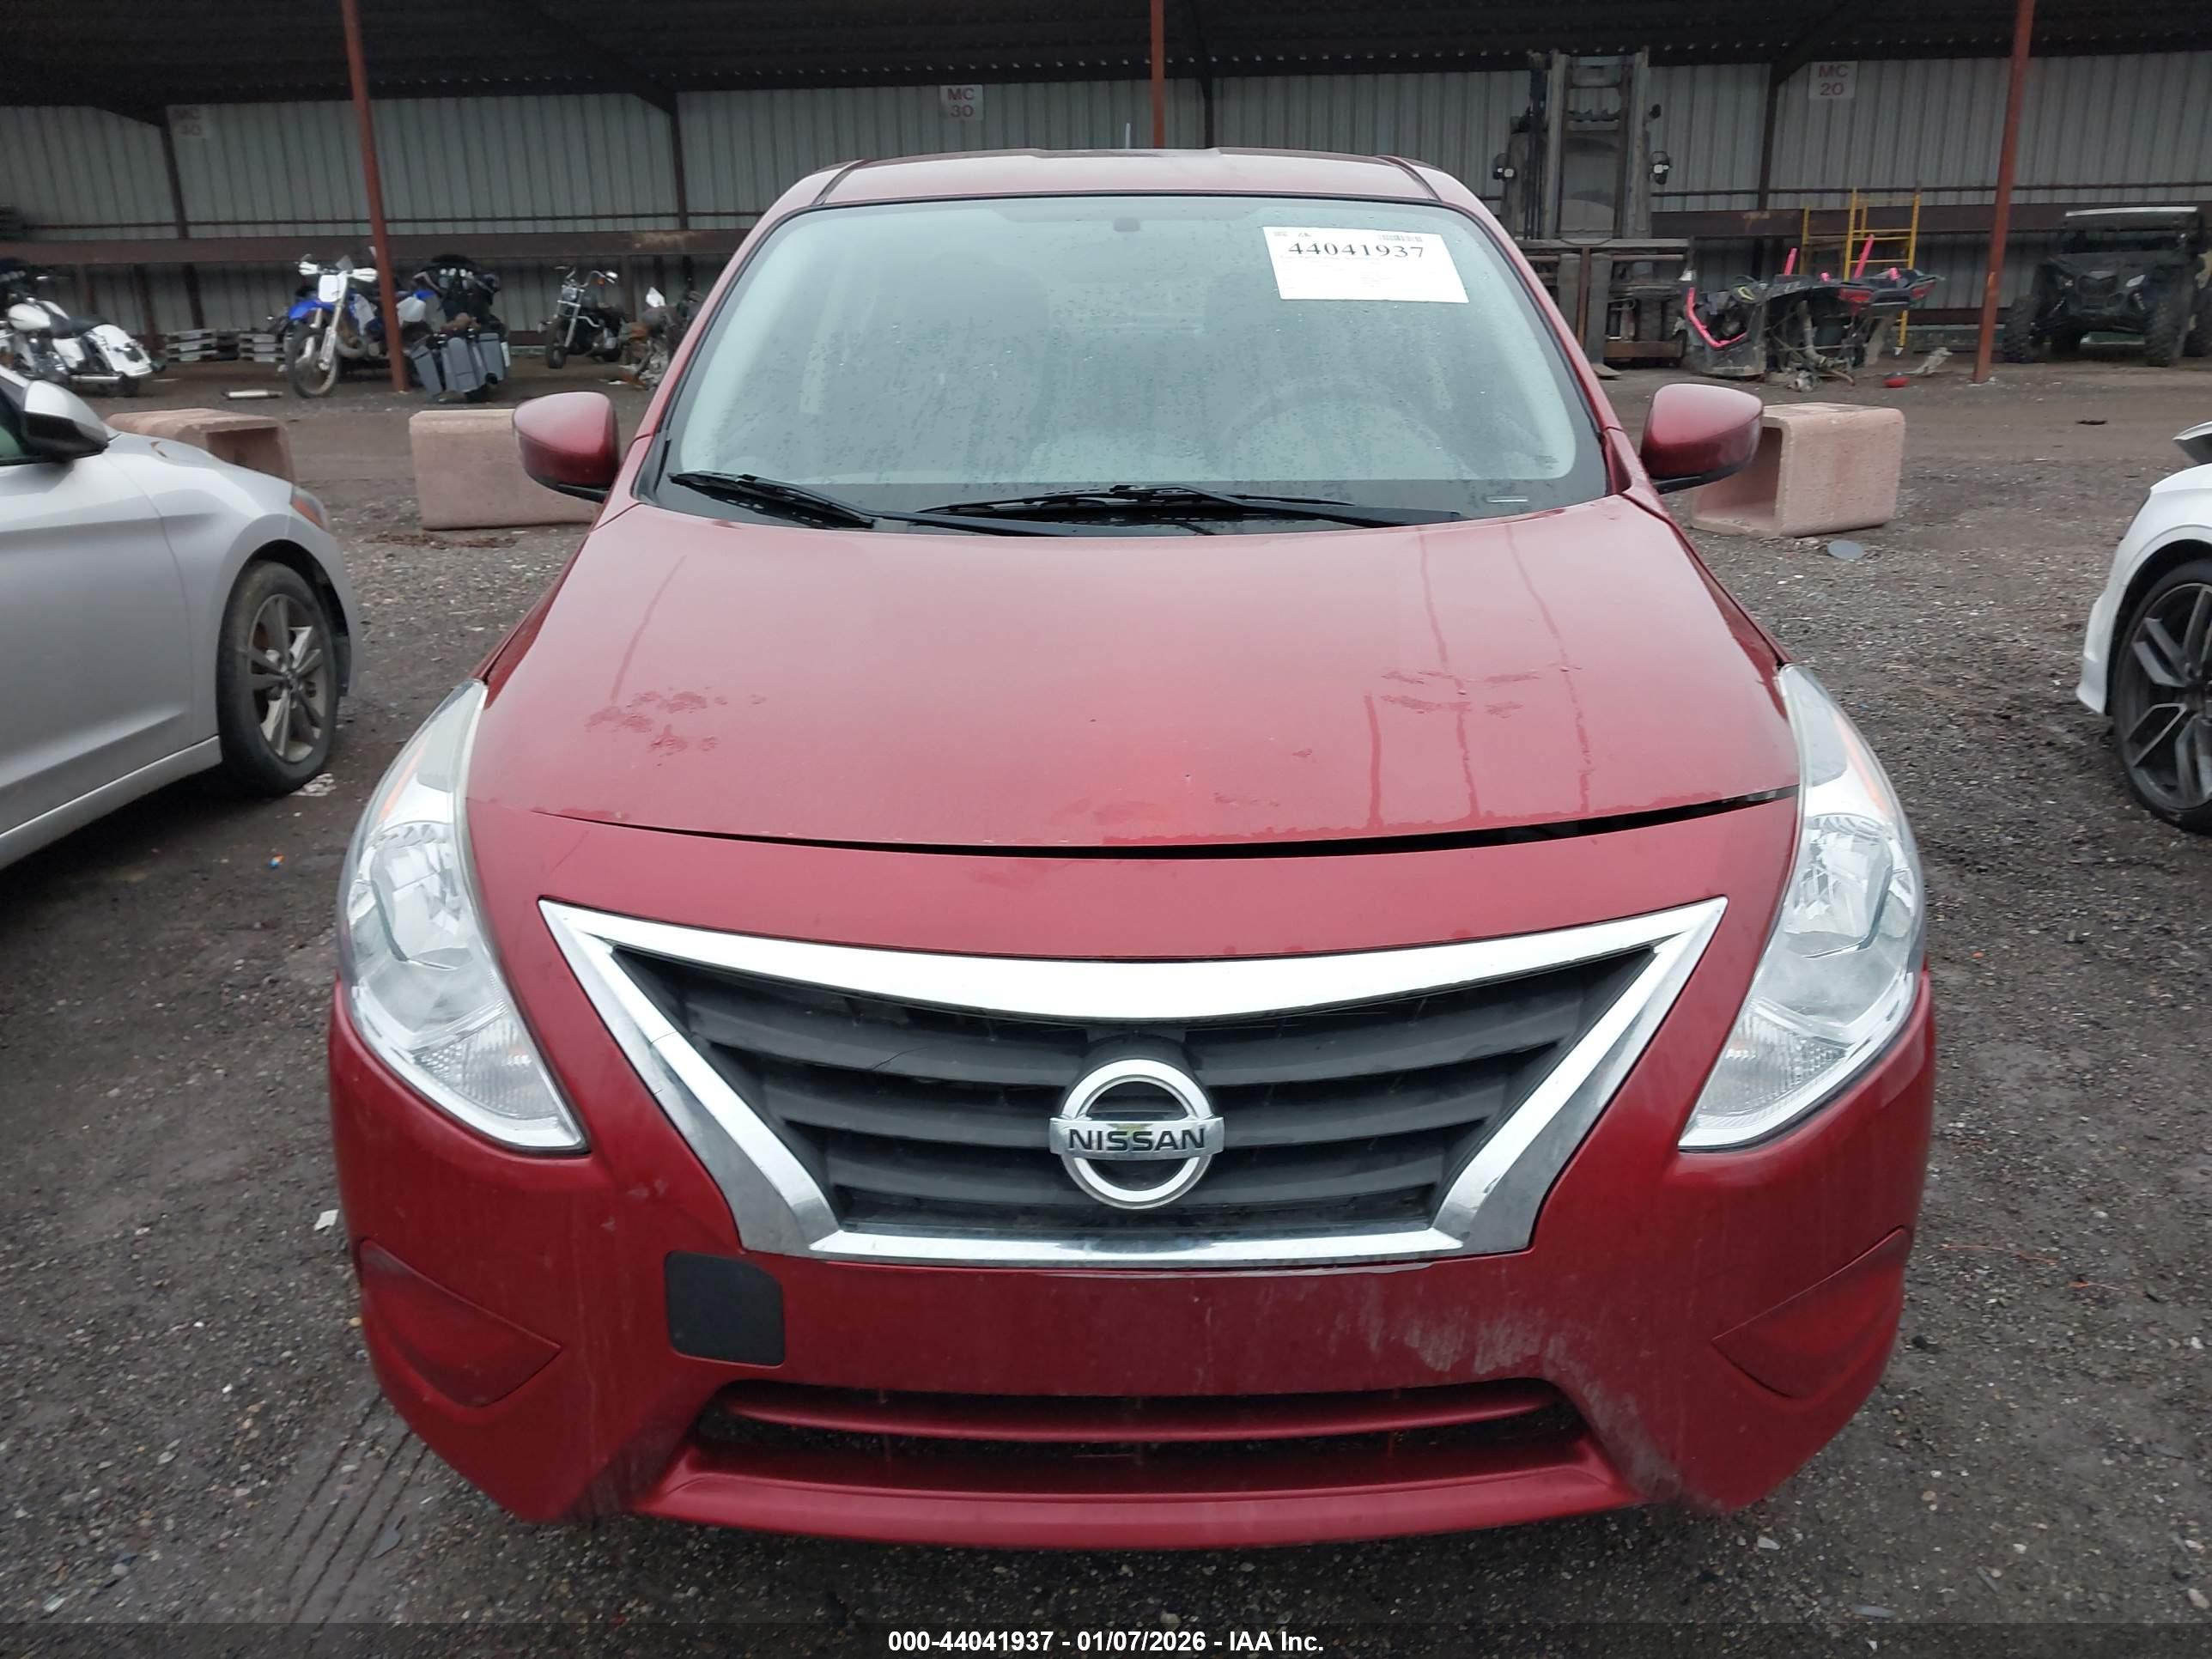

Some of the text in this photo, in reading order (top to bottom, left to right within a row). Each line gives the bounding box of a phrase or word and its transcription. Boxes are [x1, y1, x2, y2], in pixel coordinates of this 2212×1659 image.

[1818, 64, 1849, 78] MC
[948, 88, 975, 100] MC
[1820, 82, 1844, 96] 20
[950, 104, 974, 118] 30
[1288, 242, 1425, 258] 44041937
[1069, 1128, 1205, 1152] NISSAN
